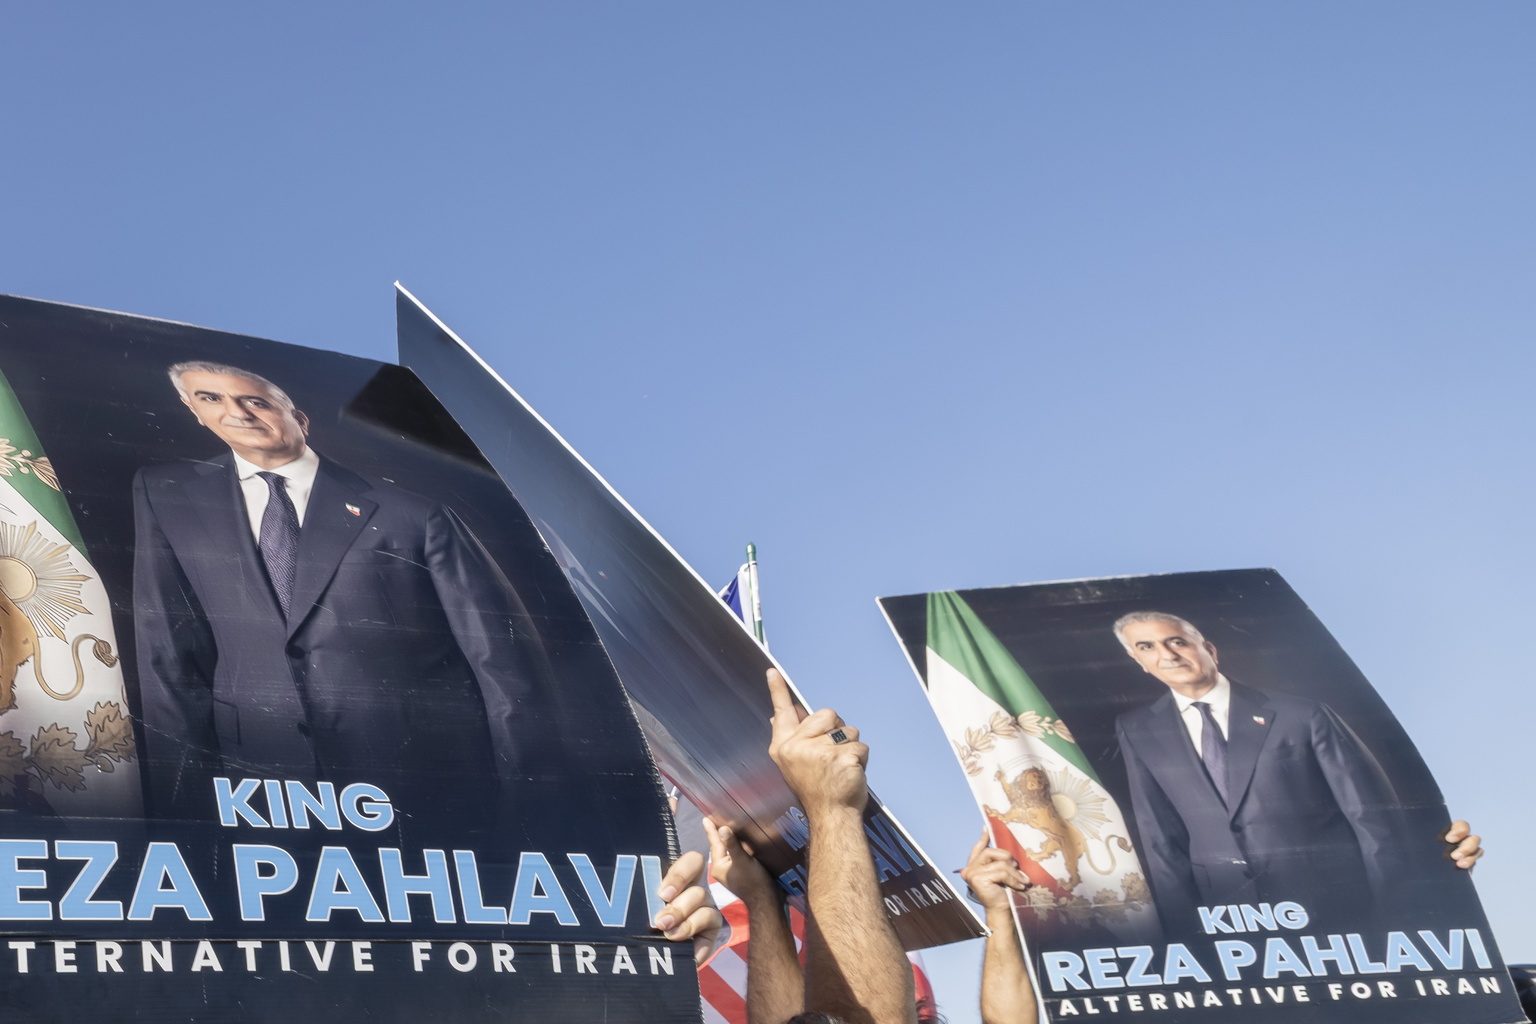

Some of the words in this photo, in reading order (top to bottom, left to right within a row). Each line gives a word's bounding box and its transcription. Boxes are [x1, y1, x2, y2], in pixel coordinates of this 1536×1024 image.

[212, 777, 394, 831] KING
[233, 845, 666, 929] PAHLAVI
[884, 893, 910, 917] OR
[905, 878, 953, 910] IRAN
[1197, 900, 1310, 935] KING
[412, 941, 517, 974] FOR
[551, 942, 675, 976] IRAN
[1041, 943, 1212, 992] REZA
[1216, 928, 1493, 982] PAHLAVI
[1059, 985, 1310, 1017] ALTERNATIVE
[1329, 979, 1397, 1000] FOR
[1418, 976, 1501, 997] IRAN
